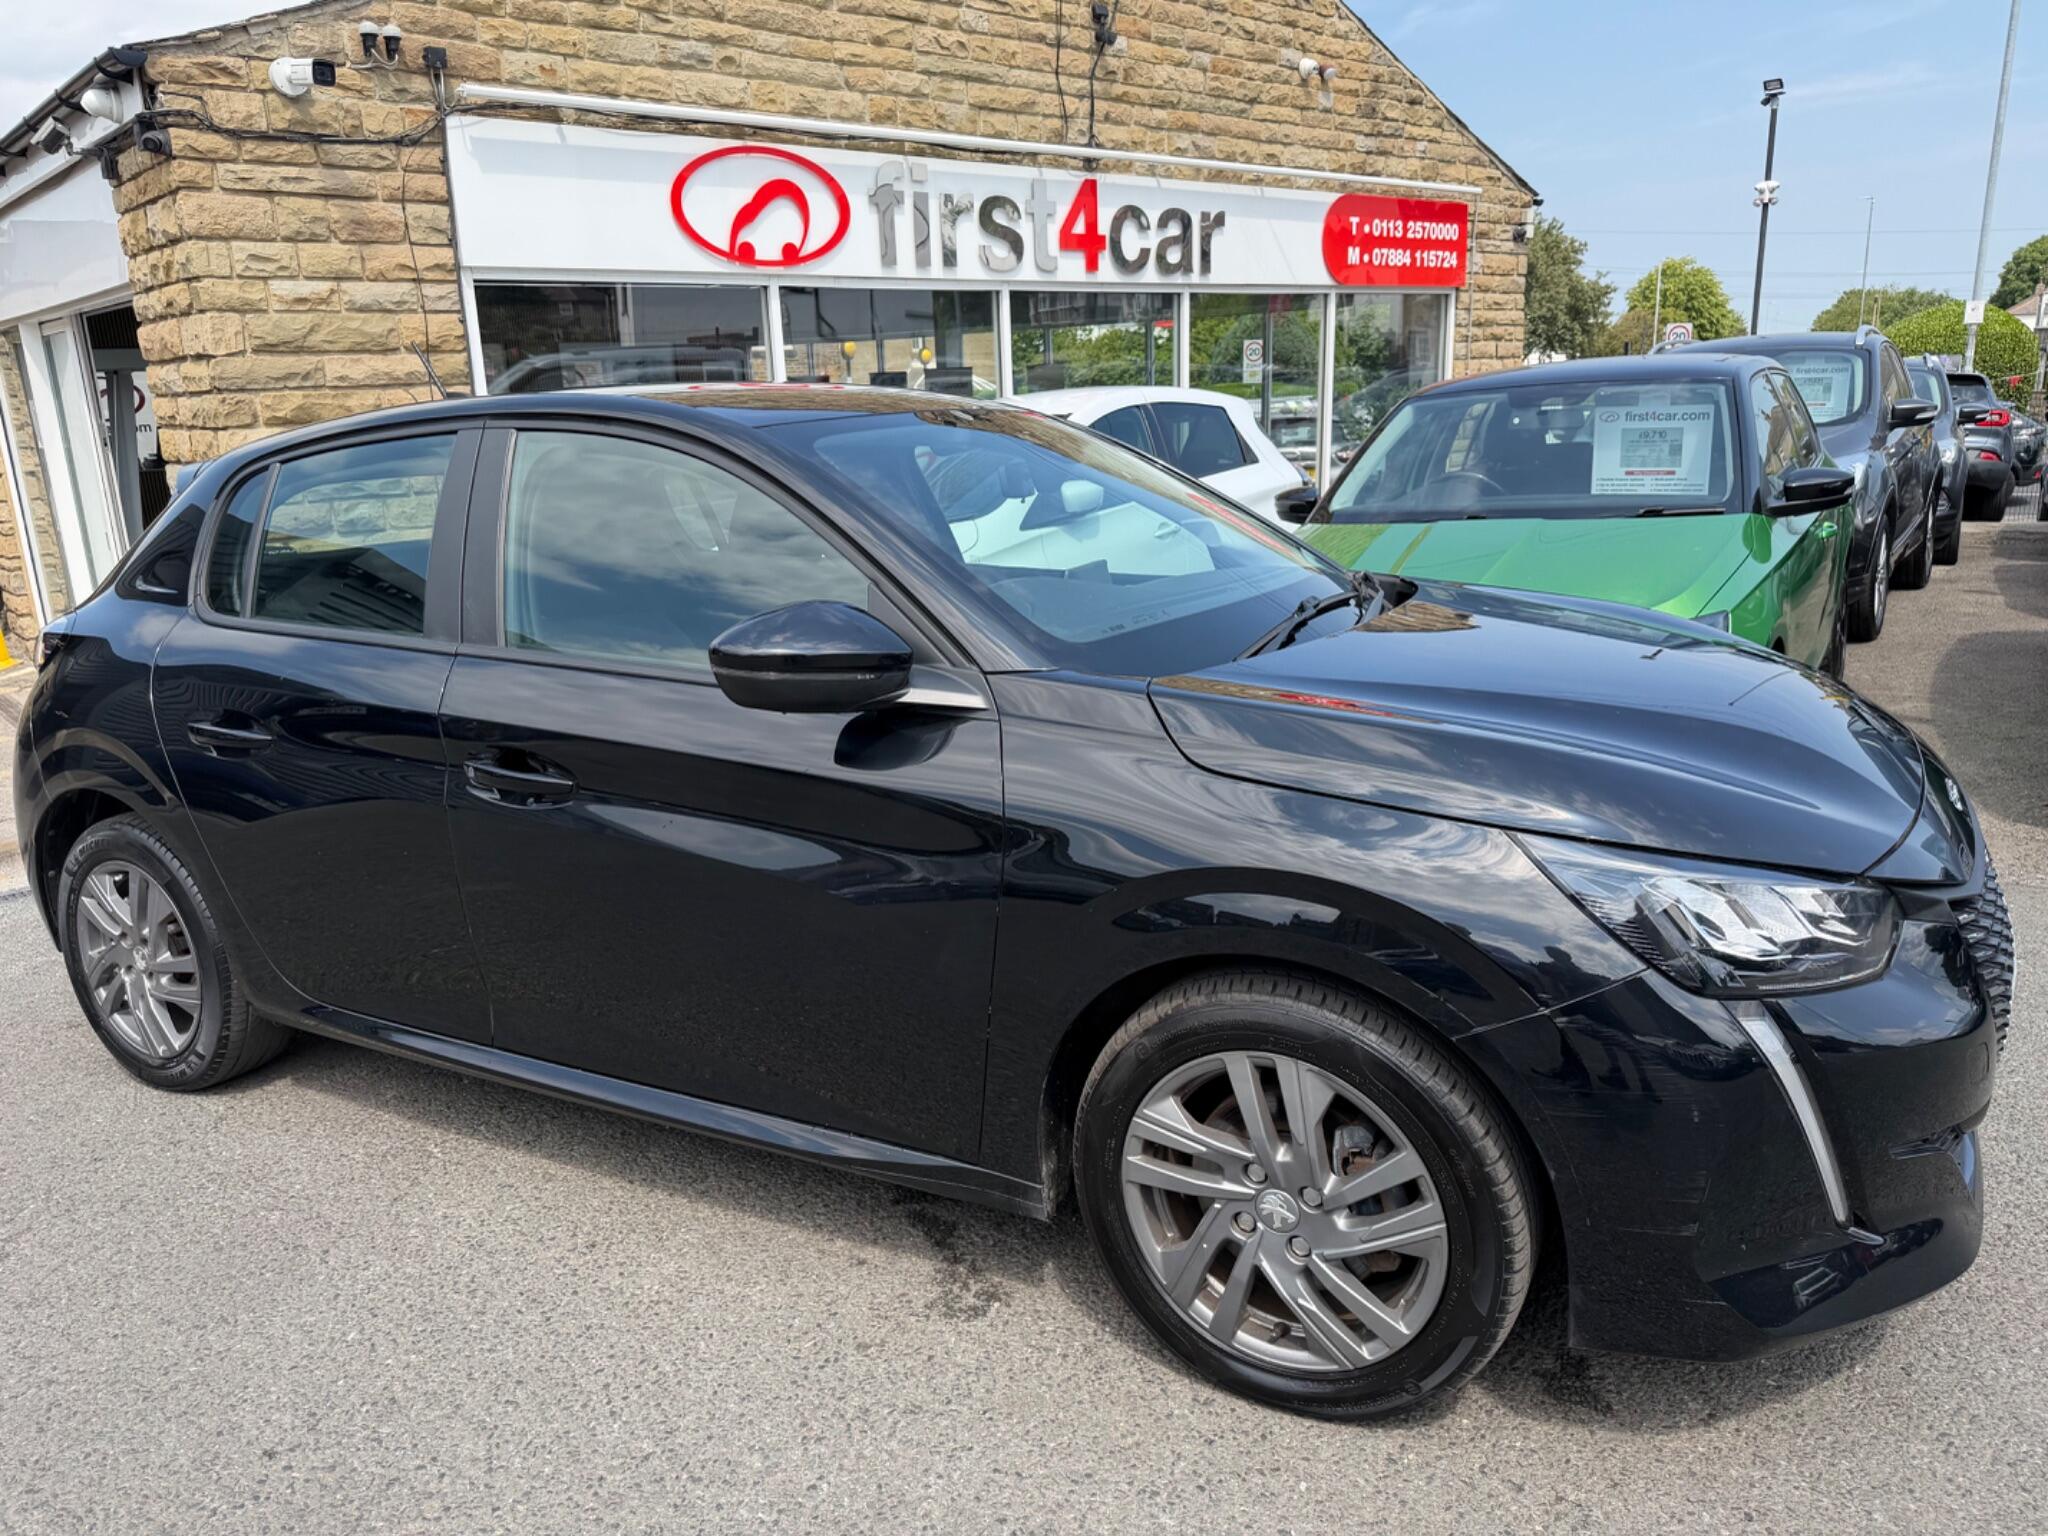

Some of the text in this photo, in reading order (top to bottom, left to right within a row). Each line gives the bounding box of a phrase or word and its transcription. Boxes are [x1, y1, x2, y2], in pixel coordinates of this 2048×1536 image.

[868, 160, 1226, 276] first4car
[1349, 216, 1459, 241] T 0113 2570000
[1347, 246, 1458, 268] M 07884 115724
[1671, 331, 1686, 341] 20
[1248, 347, 1260, 356] 20
[1625, 411, 1710, 422] first4car.com
